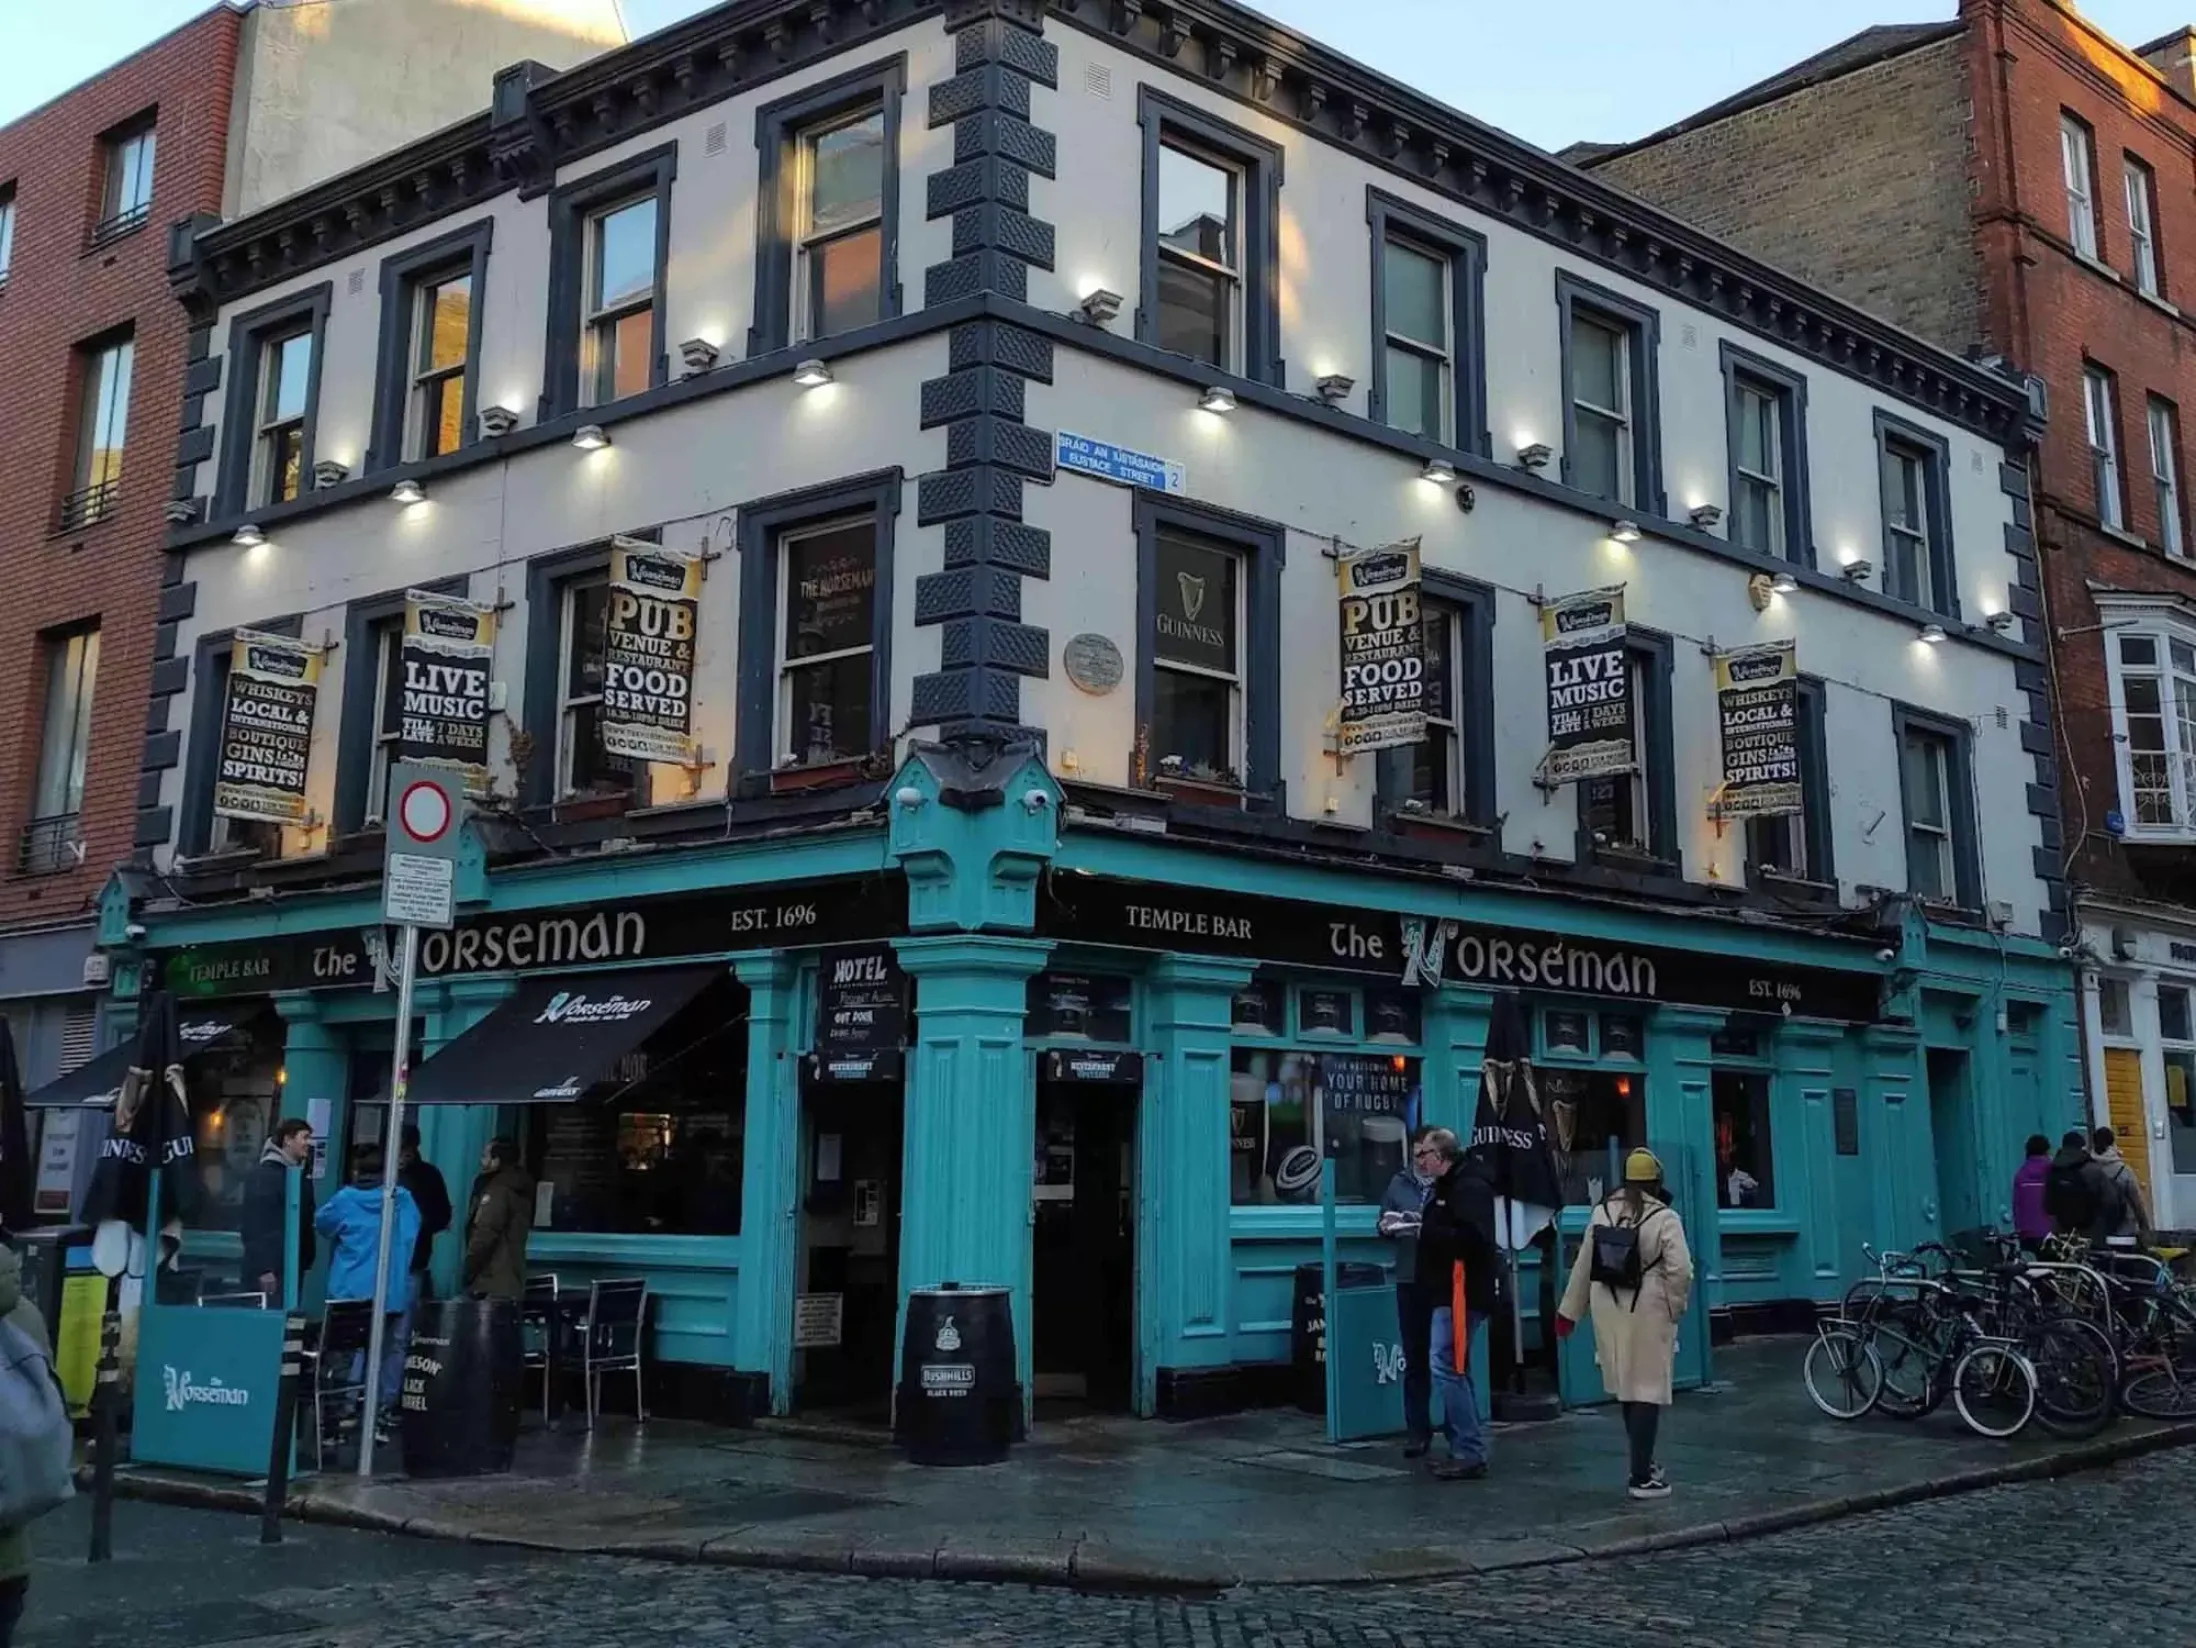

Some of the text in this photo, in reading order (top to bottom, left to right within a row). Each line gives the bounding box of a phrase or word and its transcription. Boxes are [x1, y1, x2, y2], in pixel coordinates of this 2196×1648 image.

[1069, 452, 1154, 484] EUSTACE STREET
[1171, 472, 1178, 487] 2
[610, 592, 694, 640] PUB
[1343, 590, 1420, 635] PUB
[1157, 613, 1224, 646] GUINNESS
[1343, 625, 1422, 651] VENUE &
[610, 629, 691, 660] VENUE &
[1344, 645, 1422, 660] RESTAURANT
[608, 648, 690, 672] RESTAURANT
[1344, 657, 1422, 689] FOOD
[1550, 650, 1624, 687] LIVE
[405, 661, 485, 697] LIVE
[606, 663, 686, 697] FOOD
[232, 680, 313, 705] WHISKEYS
[404, 691, 483, 719] MUSIC
[605, 689, 685, 717] SERVED
[1343, 681, 1423, 707] SERVED
[1551, 678, 1624, 709] MUSIC
[1721, 687, 1793, 708] WHISKEYS
[231, 714, 307, 734] INTERNATIONAL
[232, 698, 309, 724] LOCAL &
[1552, 711, 1580, 725] TILL
[1592, 702, 1625, 718] DAYS
[1723, 703, 1793, 725] LOCAL &
[228, 727, 307, 751] BOUTIQUE
[402, 717, 483, 737] TILL 7 DAYS
[402, 729, 434, 743] LATE
[1553, 722, 1580, 735] LATE
[1724, 718, 1794, 735] INTERNATIONAL
[226, 743, 274, 765] GINS
[1725, 732, 1795, 751] BOUTIQUE
[1726, 748, 1767, 767] GINS
[223, 760, 303, 786] SPIRITS!
[1726, 761, 1797, 783] SPIRITS!
[731, 904, 816, 931] EST. 1696
[1126, 905, 1252, 939] TEMPLE BAR
[1330, 923, 1383, 958] The
[190, 957, 270, 983] TEMPLE BAR
[313, 948, 357, 976] The
[833, 956, 887, 983] HOTEL
[1749, 979, 1773, 998] EST.
[1327, 1072, 1408, 1092] YOUR HOME
[1334, 1093, 1398, 1110] OF RUGBY
[924, 1370, 972, 1381] BUSHMILLS
